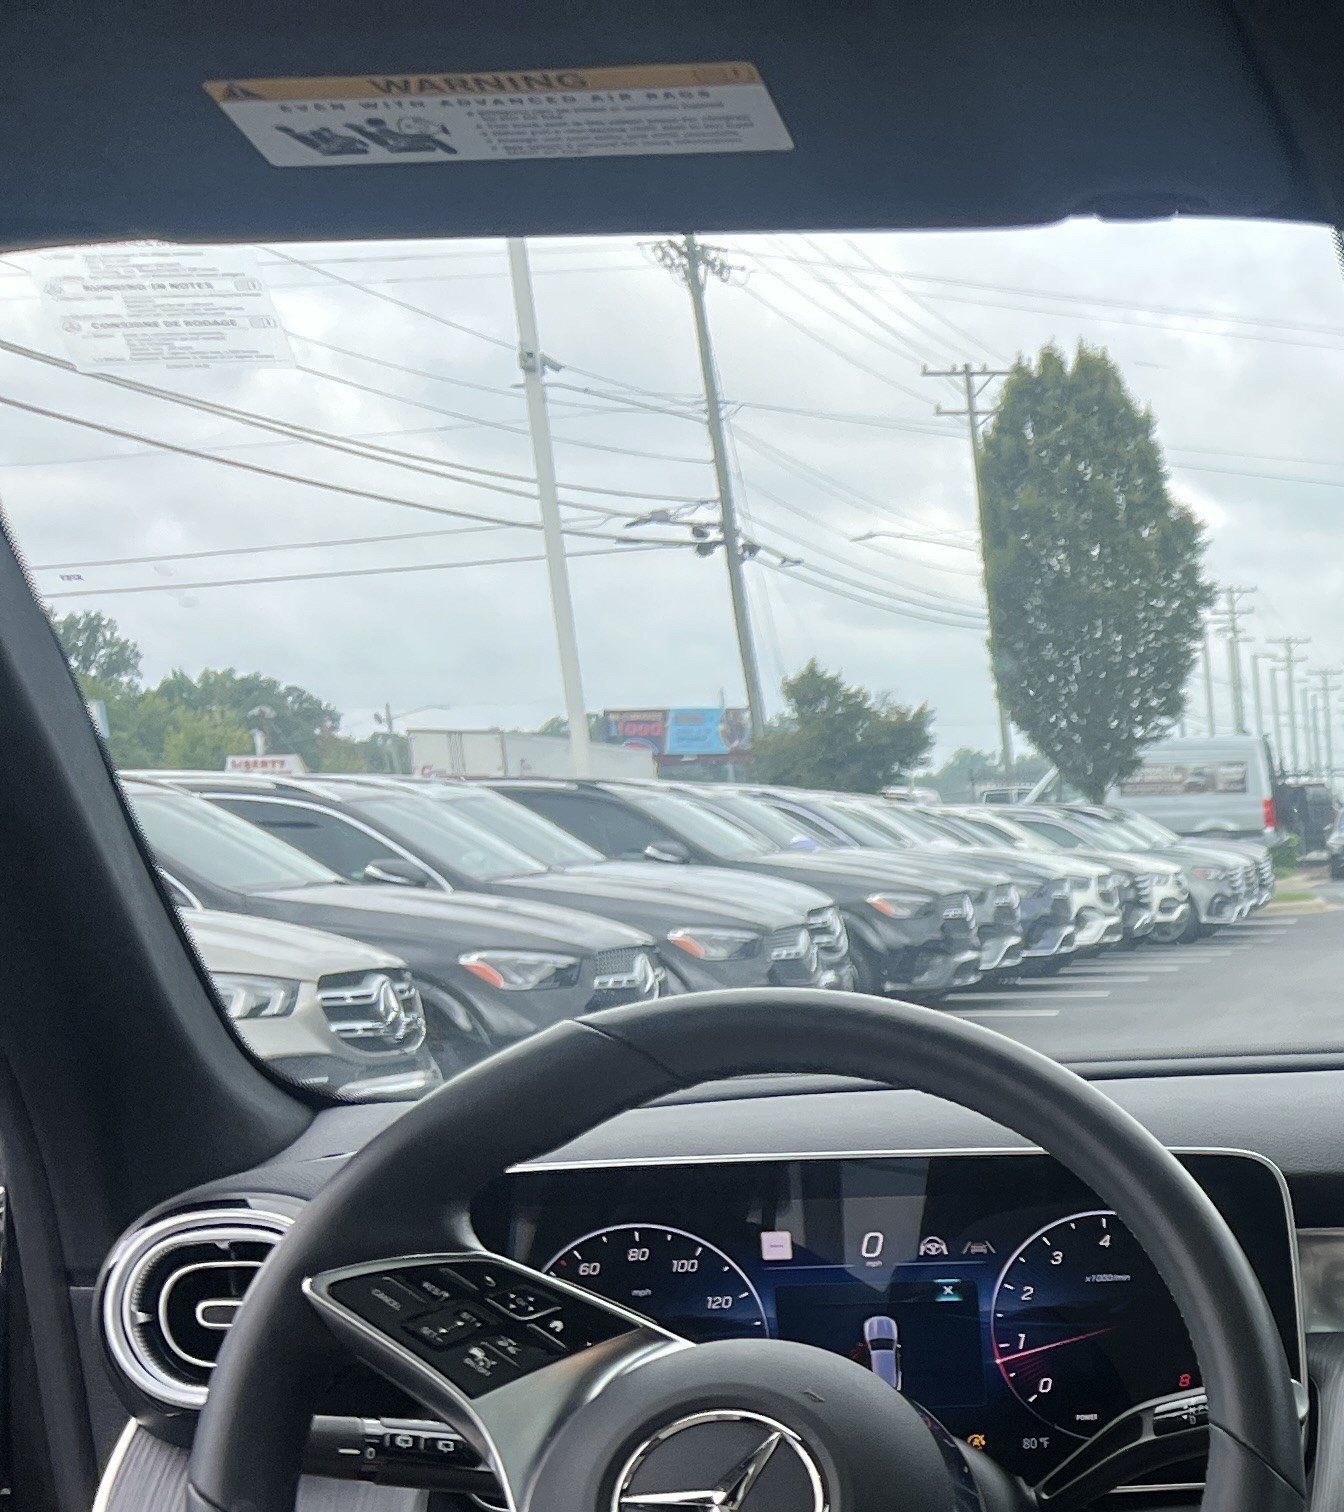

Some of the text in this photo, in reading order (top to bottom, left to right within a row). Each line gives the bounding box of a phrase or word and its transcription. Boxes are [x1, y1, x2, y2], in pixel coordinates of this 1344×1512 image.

[368, 71, 587, 95] WARNING
[359, 100, 425, 111] WITH
[591, 92, 632, 102] AIR
[861, 1231, 884, 1259] 0
[1099, 1234, 1111, 1248] 4
[627, 1248, 650, 1262] 80
[1050, 1251, 1064, 1265] 3
[579, 1262, 600, 1276] 60
[672, 1259, 698, 1273] 100
[631, 1288, 652, 1298] mph
[1021, 1286, 1034, 1301] 2
[706, 1296, 733, 1309] 120
[1018, 1333, 1026, 1350] 1
[1038, 1377, 1053, 1393] 0
[1178, 1373, 1191, 1387] 8
[1022, 1437, 1038, 1450] 80
